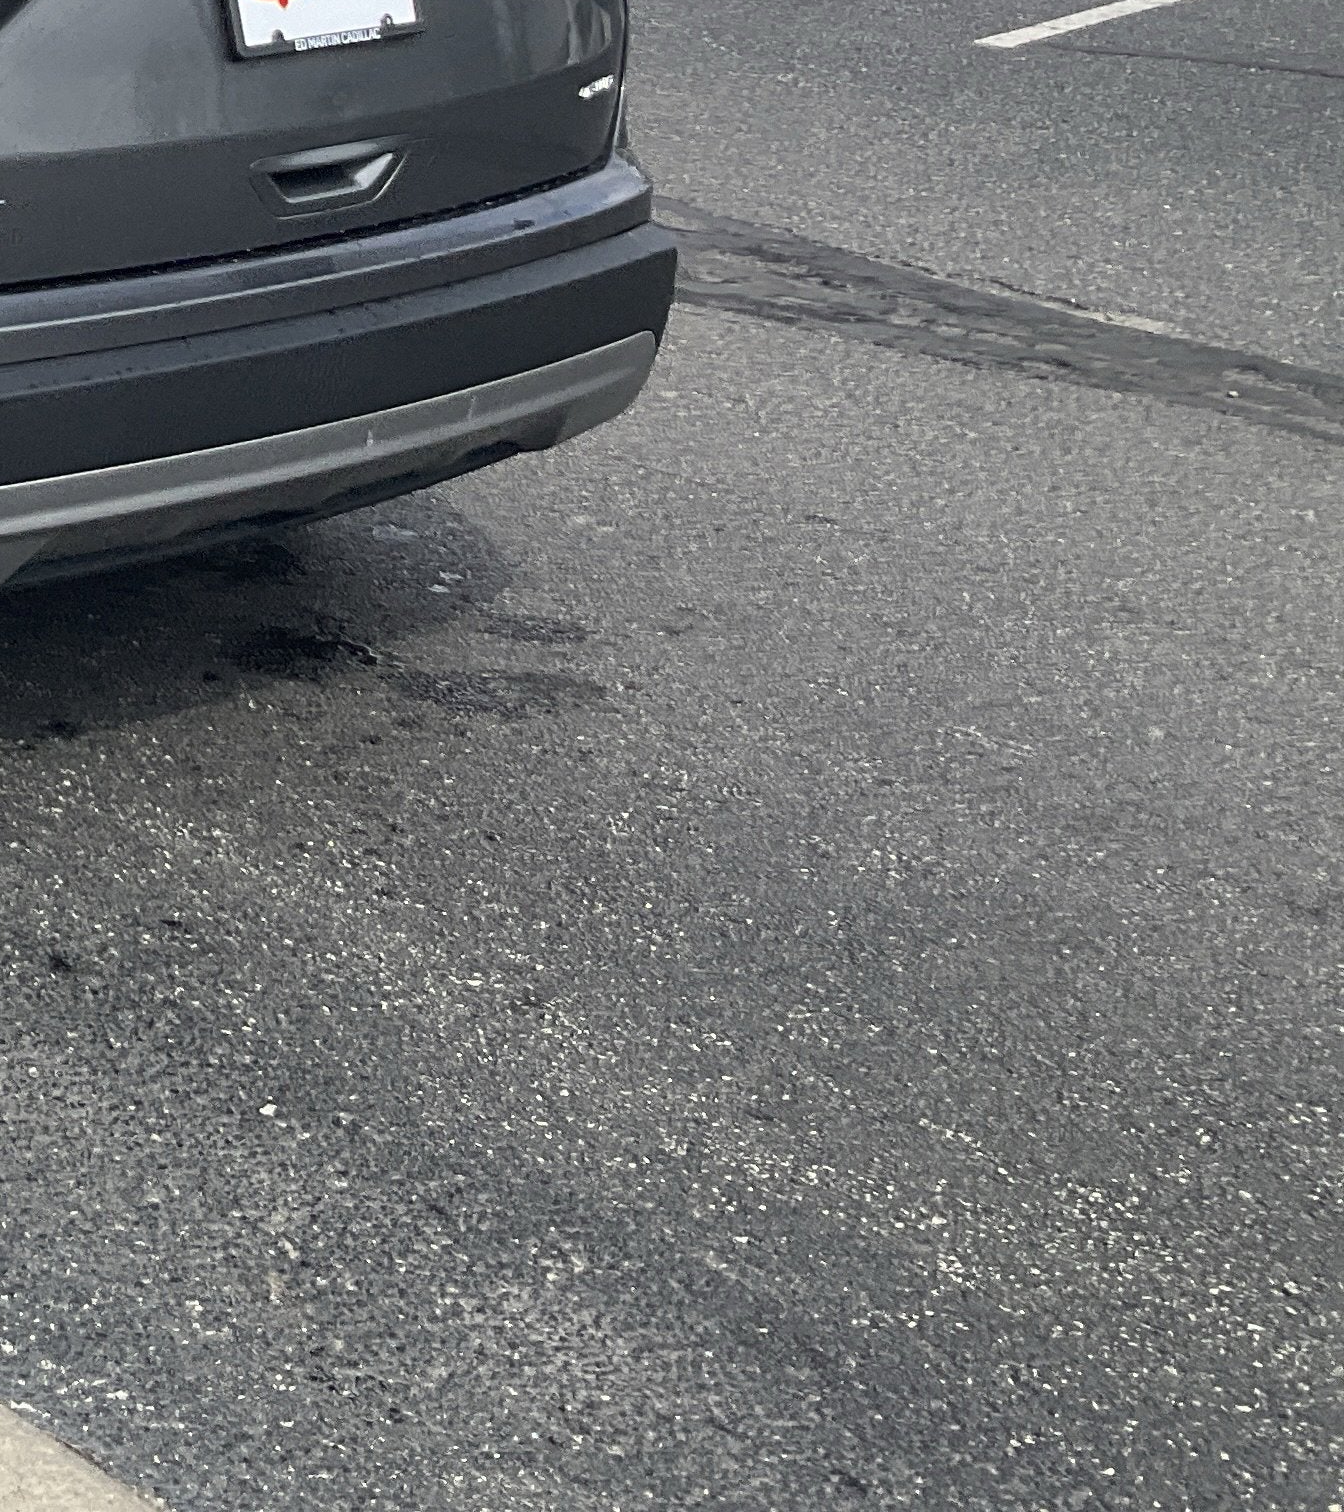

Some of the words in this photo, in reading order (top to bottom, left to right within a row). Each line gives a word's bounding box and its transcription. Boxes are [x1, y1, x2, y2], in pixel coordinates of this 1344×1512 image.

[294, 38, 308, 51] ED
[308, 33, 341, 49] MARTIN
[341, 28, 381, 45] CADILLAC
